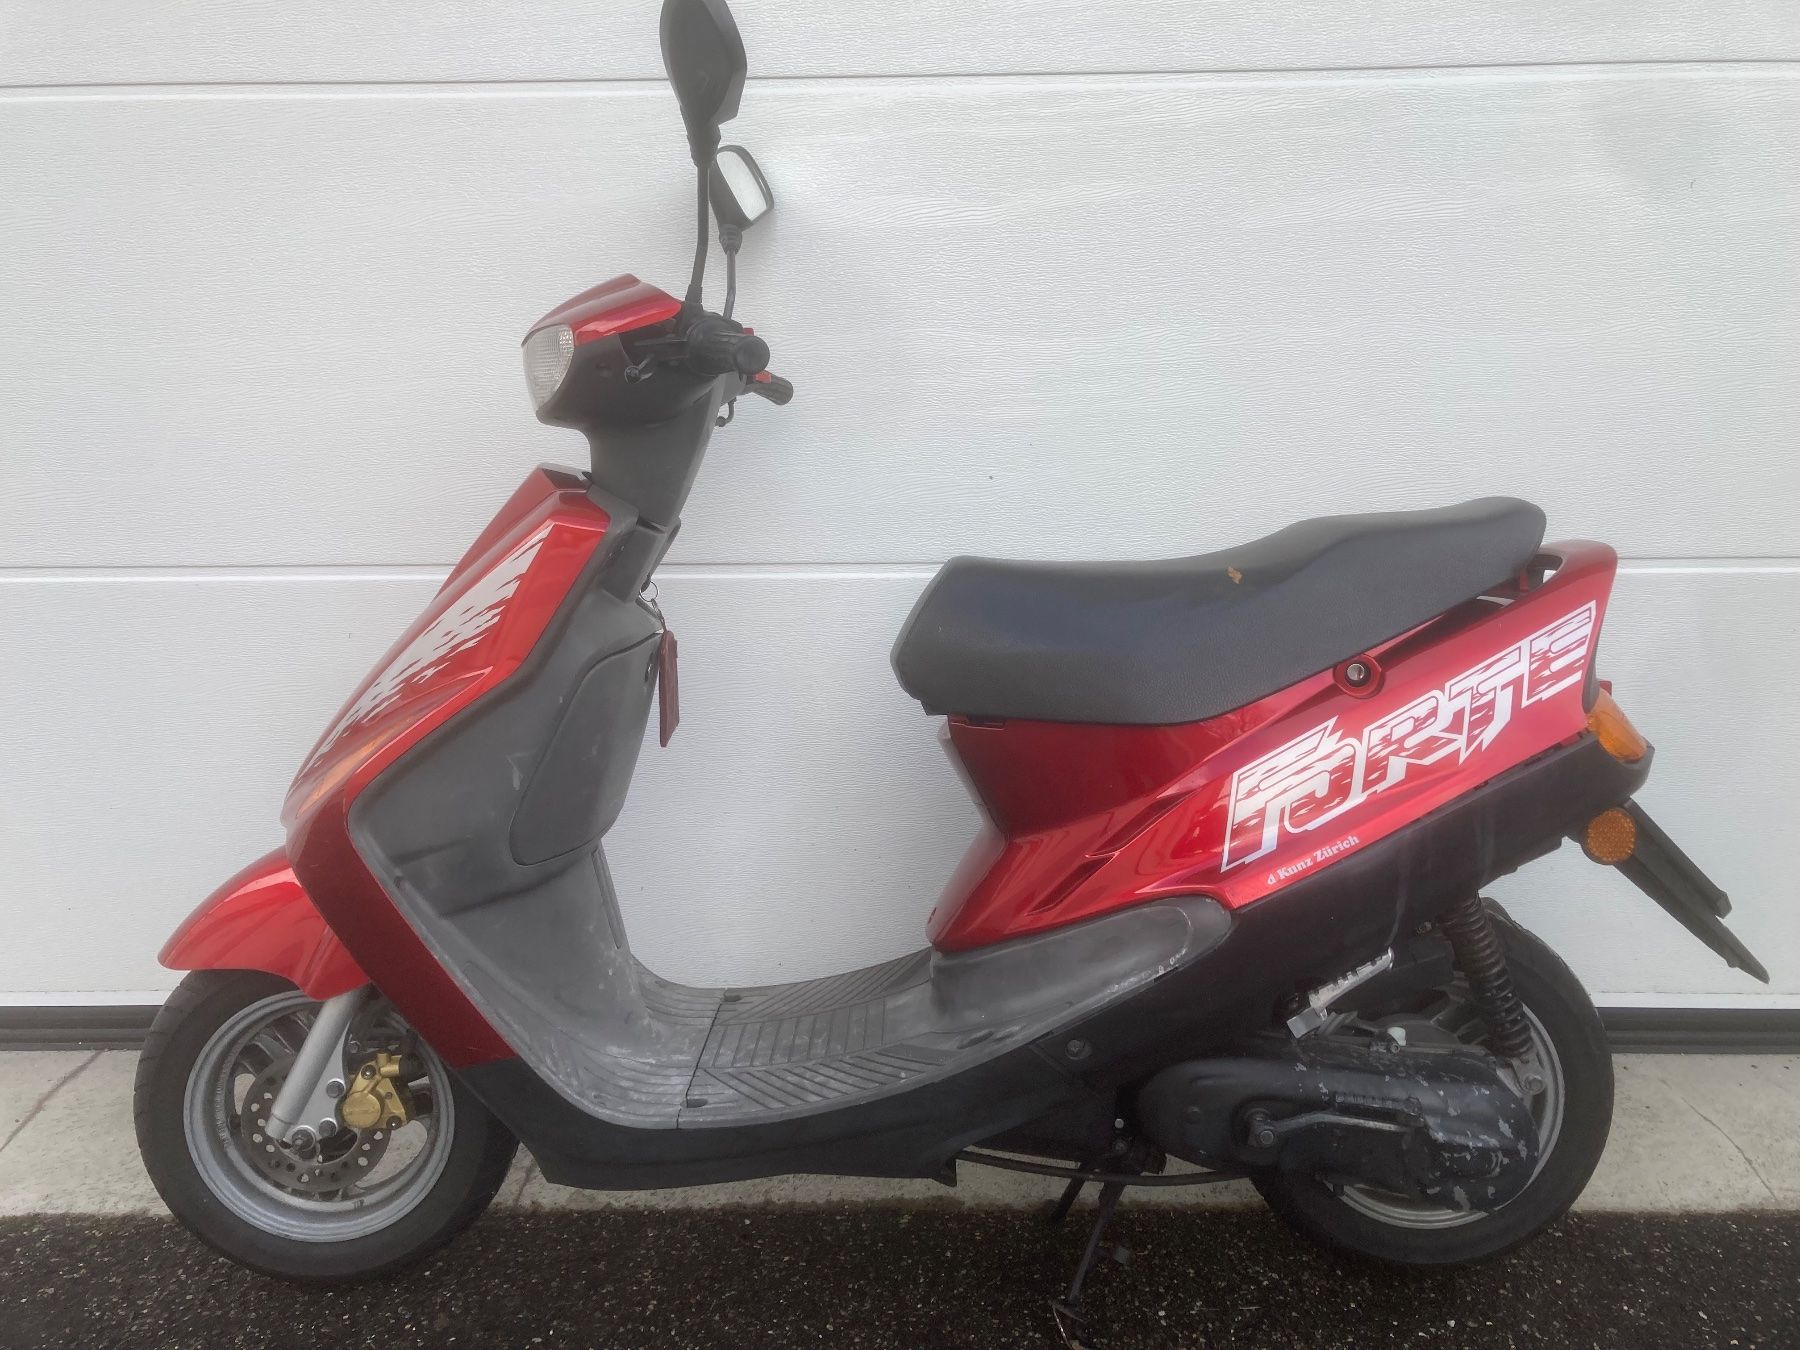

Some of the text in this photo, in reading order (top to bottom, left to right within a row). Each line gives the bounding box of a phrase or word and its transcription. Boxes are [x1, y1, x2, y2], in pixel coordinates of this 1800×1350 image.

[1220, 600, 1597, 873] FORTE
[1276, 857, 1314, 880] Kunz
[1313, 835, 1360, 863] Zürich
